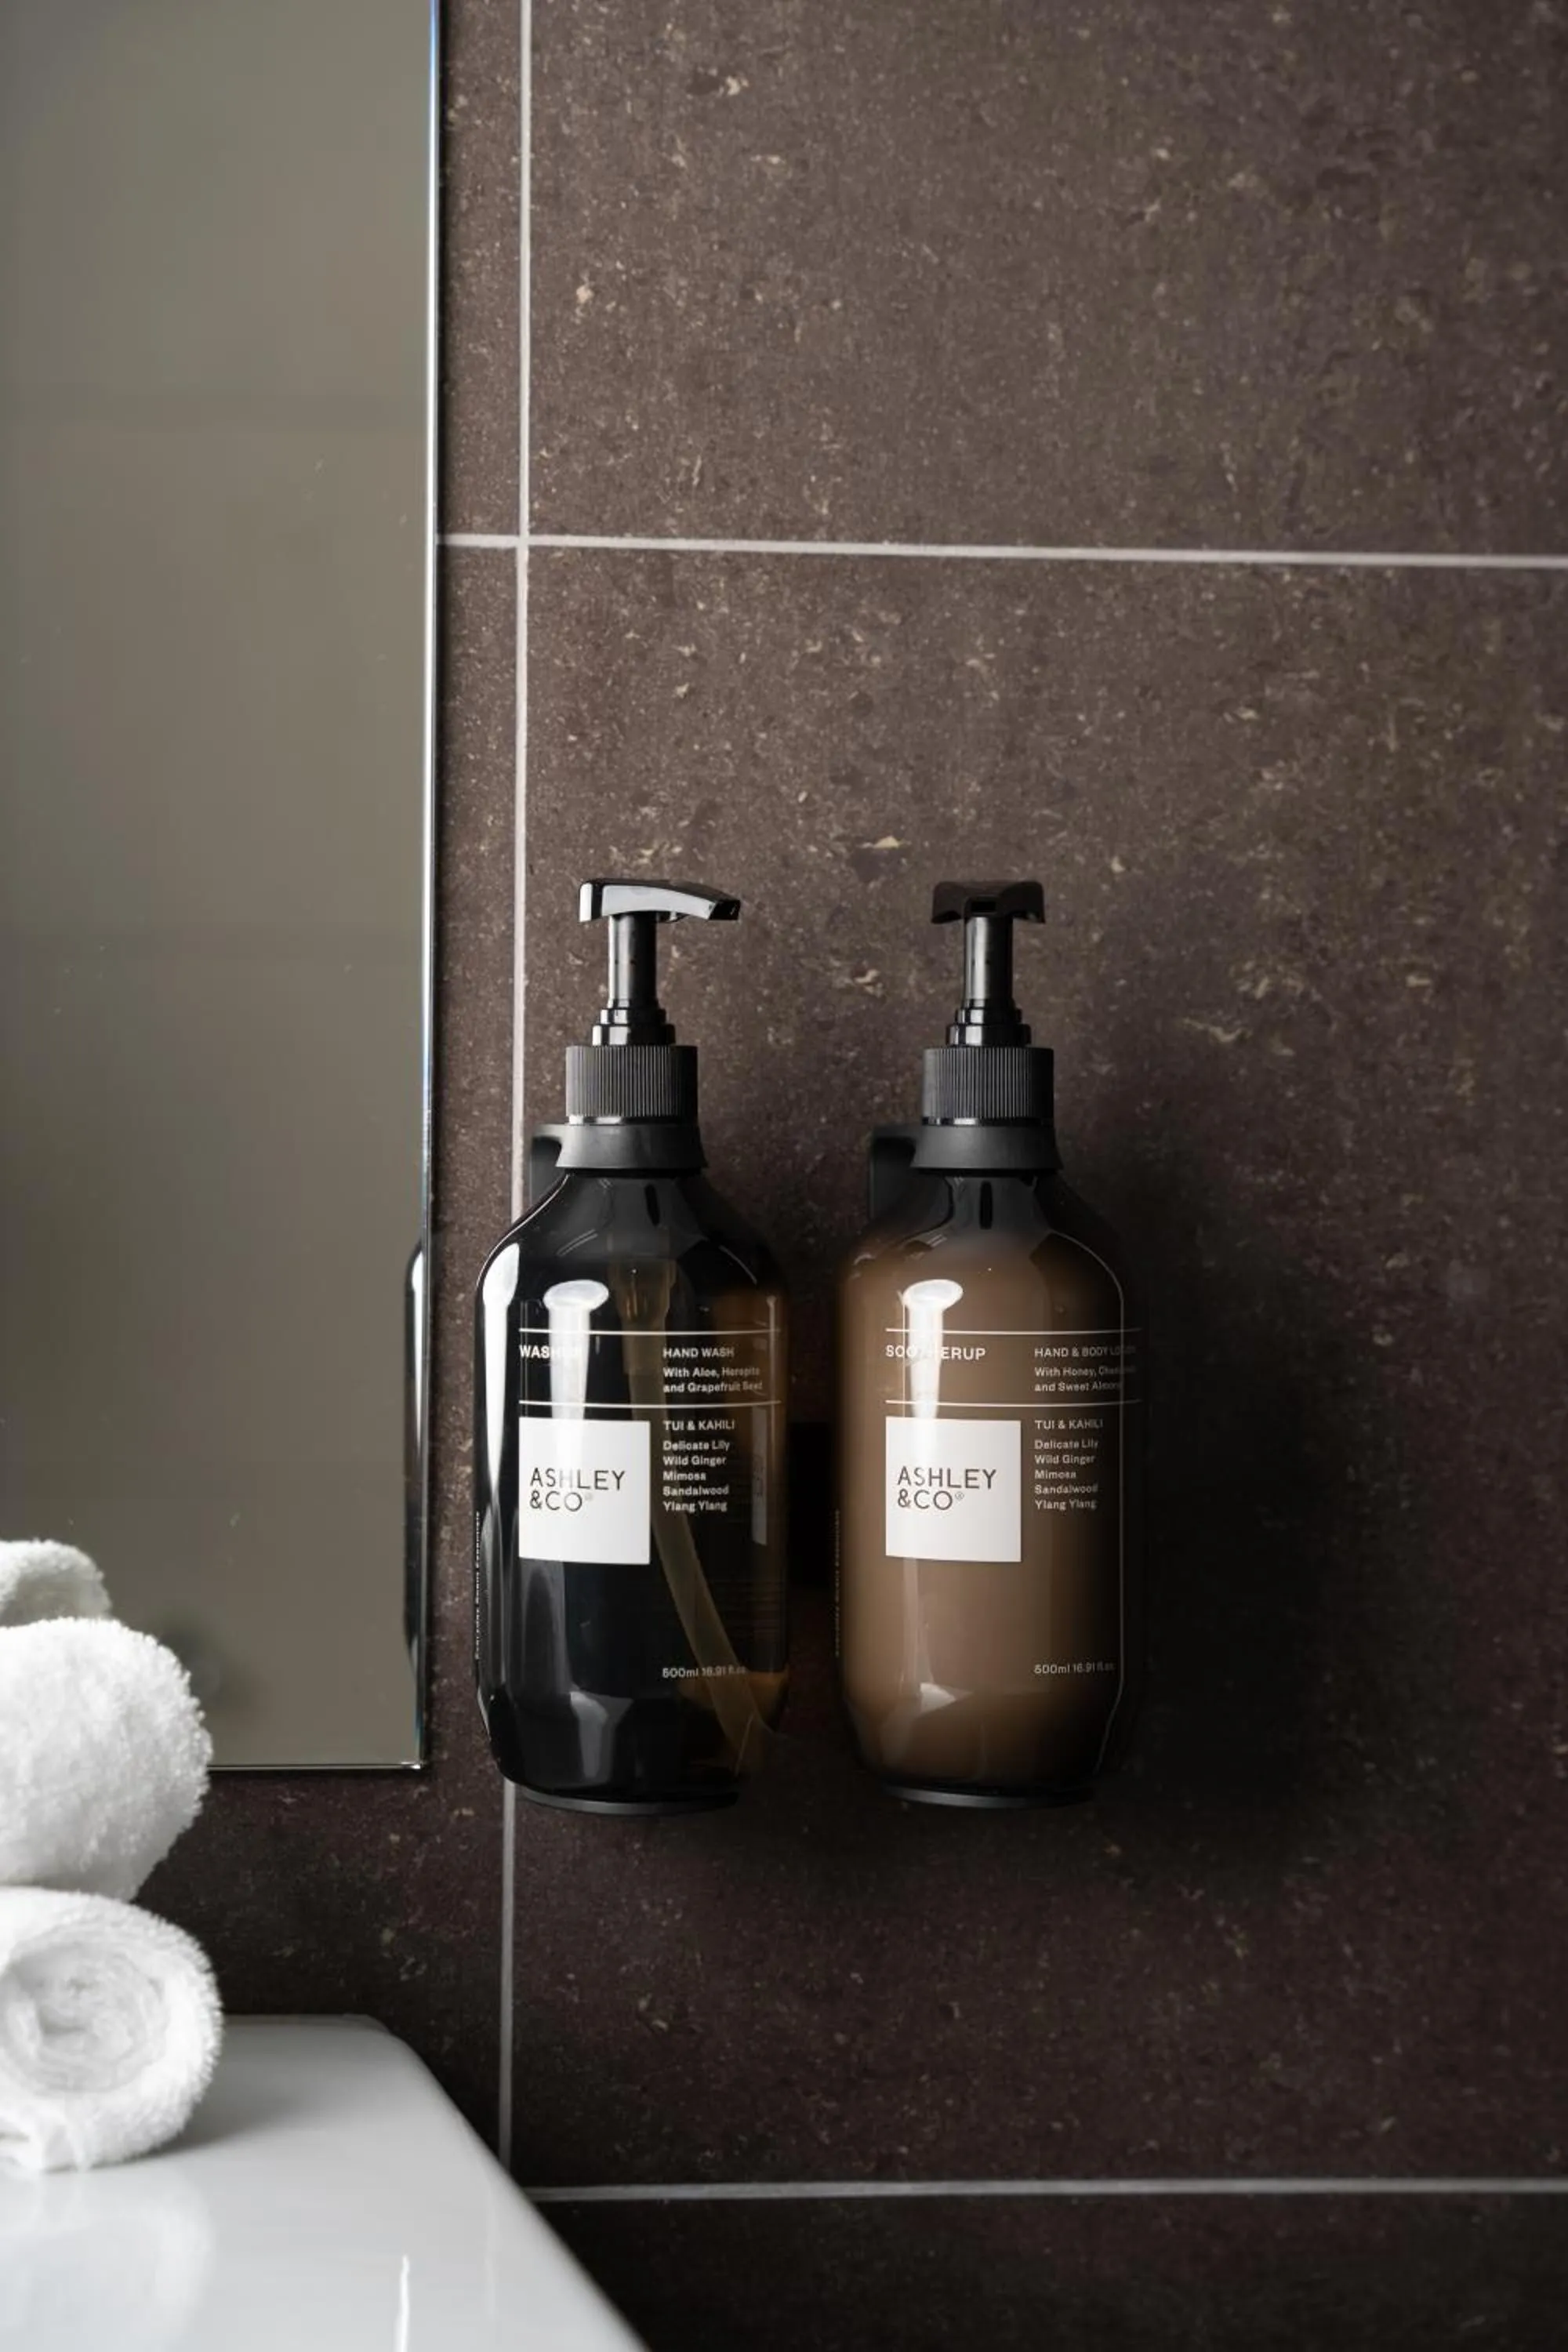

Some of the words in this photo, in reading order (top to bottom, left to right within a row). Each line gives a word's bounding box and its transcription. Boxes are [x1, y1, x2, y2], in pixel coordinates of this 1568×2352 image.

[662, 1347, 699, 1358] HAND
[701, 1346, 735, 1358] WASH
[885, 1344, 986, 1361] SOOERUP
[1034, 1346, 1069, 1358] HAND
[1072, 1346, 1080, 1358] &
[662, 1367, 690, 1377] With
[692, 1367, 720, 1378] Aloe,
[1034, 1367, 1061, 1377] With
[662, 1383, 685, 1392] and
[688, 1381, 741, 1395] Grapefruit
[1034, 1382, 1056, 1392] and
[1058, 1381, 1090, 1392] Sweet
[662, 1420, 684, 1431] TUI
[687, 1420, 695, 1431] &
[698, 1418, 736, 1431] KAHILI
[1034, 1419, 1055, 1430] TUI
[1058, 1419, 1065, 1429] &
[662, 1440, 710, 1452] Delicate
[711, 1439, 730, 1452] Lily
[1034, 1439, 1080, 1450] Delicate
[662, 1455, 689, 1466] Wild
[691, 1454, 727, 1468] Ginger
[1034, 1454, 1060, 1465] Wild
[1062, 1454, 1096, 1466] Ginger
[529, 1467, 626, 1491] ASHLEY
[662, 1470, 706, 1481] Mimosa
[897, 1465, 996, 1490] ASHLEY
[1034, 1469, 1076, 1480] Mimosa
[662, 1484, 730, 1497] Sandalwood
[662, 1500, 695, 1513] Ylang
[697, 1499, 728, 1512] Ylang
[1034, 1498, 1066, 1512] Ylang
[662, 1667, 699, 1679] 500ml
[1033, 1663, 1070, 1675] 500ml
